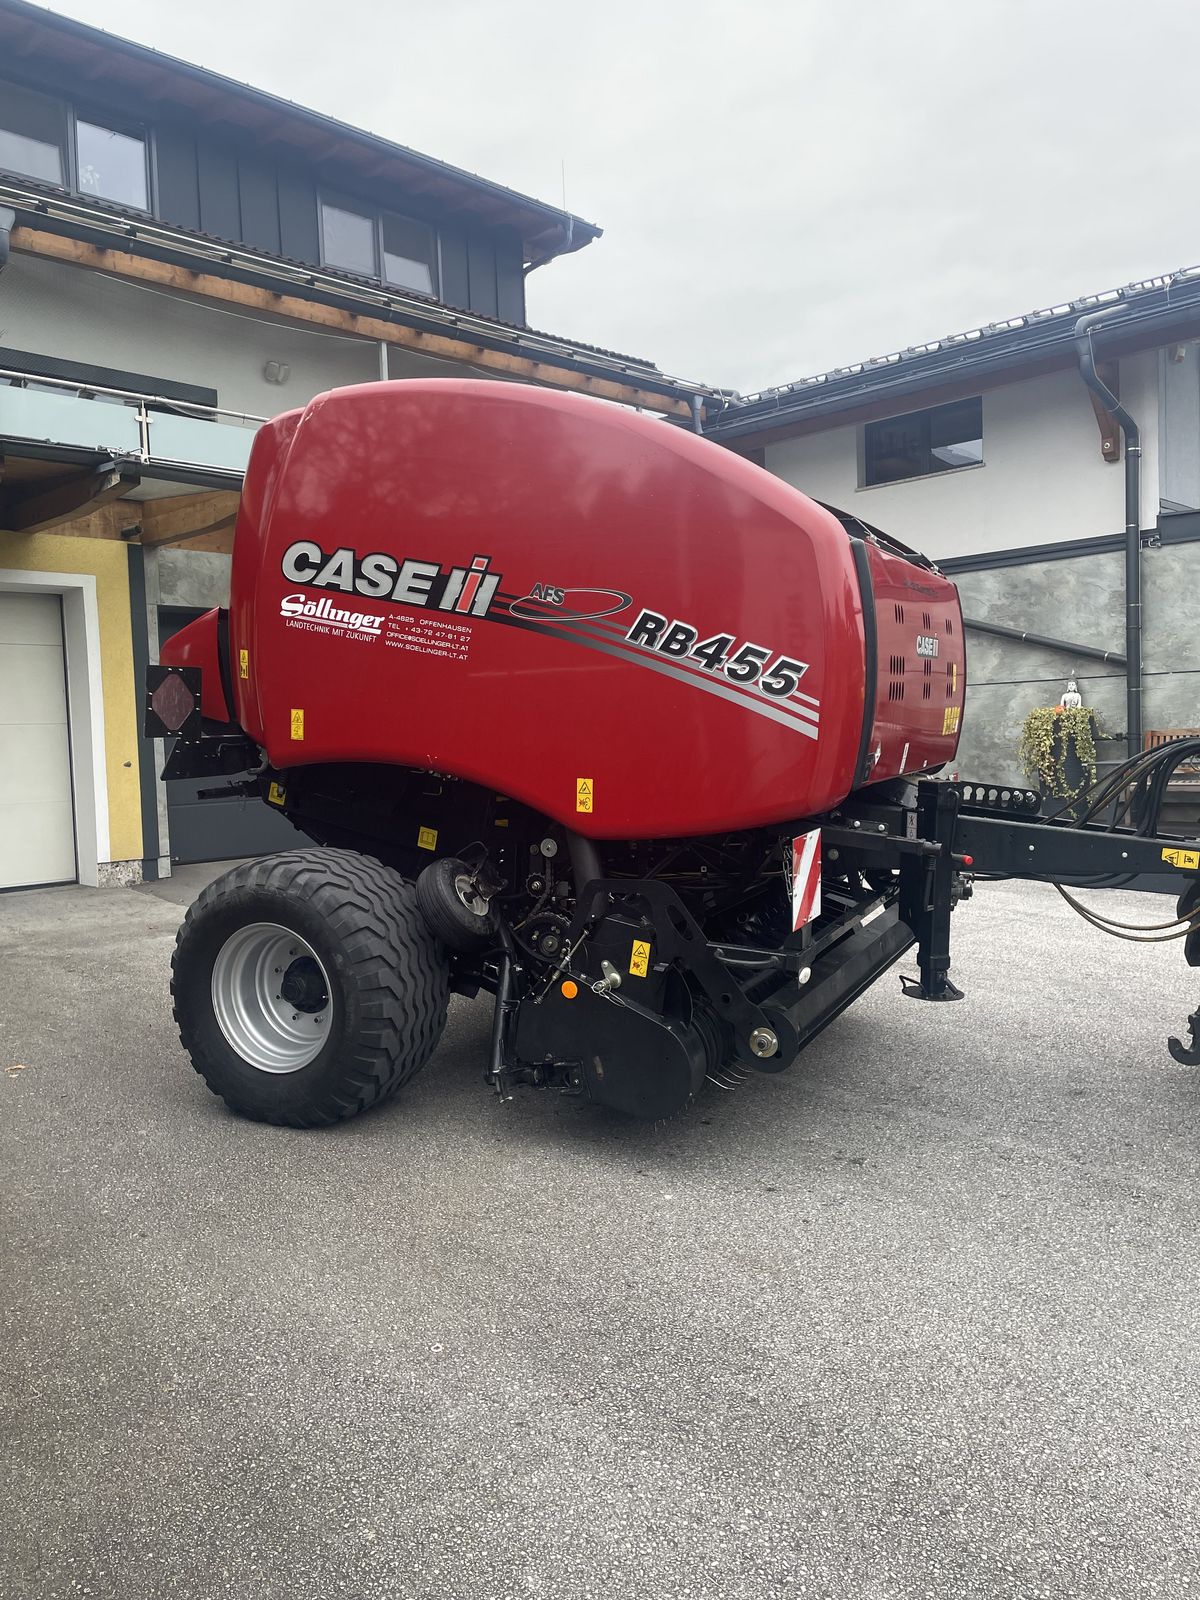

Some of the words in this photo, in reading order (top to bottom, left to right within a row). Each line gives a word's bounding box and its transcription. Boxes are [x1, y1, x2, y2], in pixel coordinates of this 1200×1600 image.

[281, 540, 442, 606] CASE
[529, 582, 565, 606] AFS
[285, 619, 330, 634] LANDTECHNIK
[332, 628, 345, 637] MIT
[346, 630, 377, 643] ZUKUNFT
[388, 613, 415, 624] A-4625
[419, 619, 473, 634] OFFENHAUSEN
[386, 631, 469, 652] OFFICE@SOELLINGER-LT.AT
[459, 635, 471, 643] 27
[917, 635, 933, 656] CASE
[385, 640, 469, 661] WWW.SOELLINGER-LT.AT
[624, 608, 810, 699] RB455
